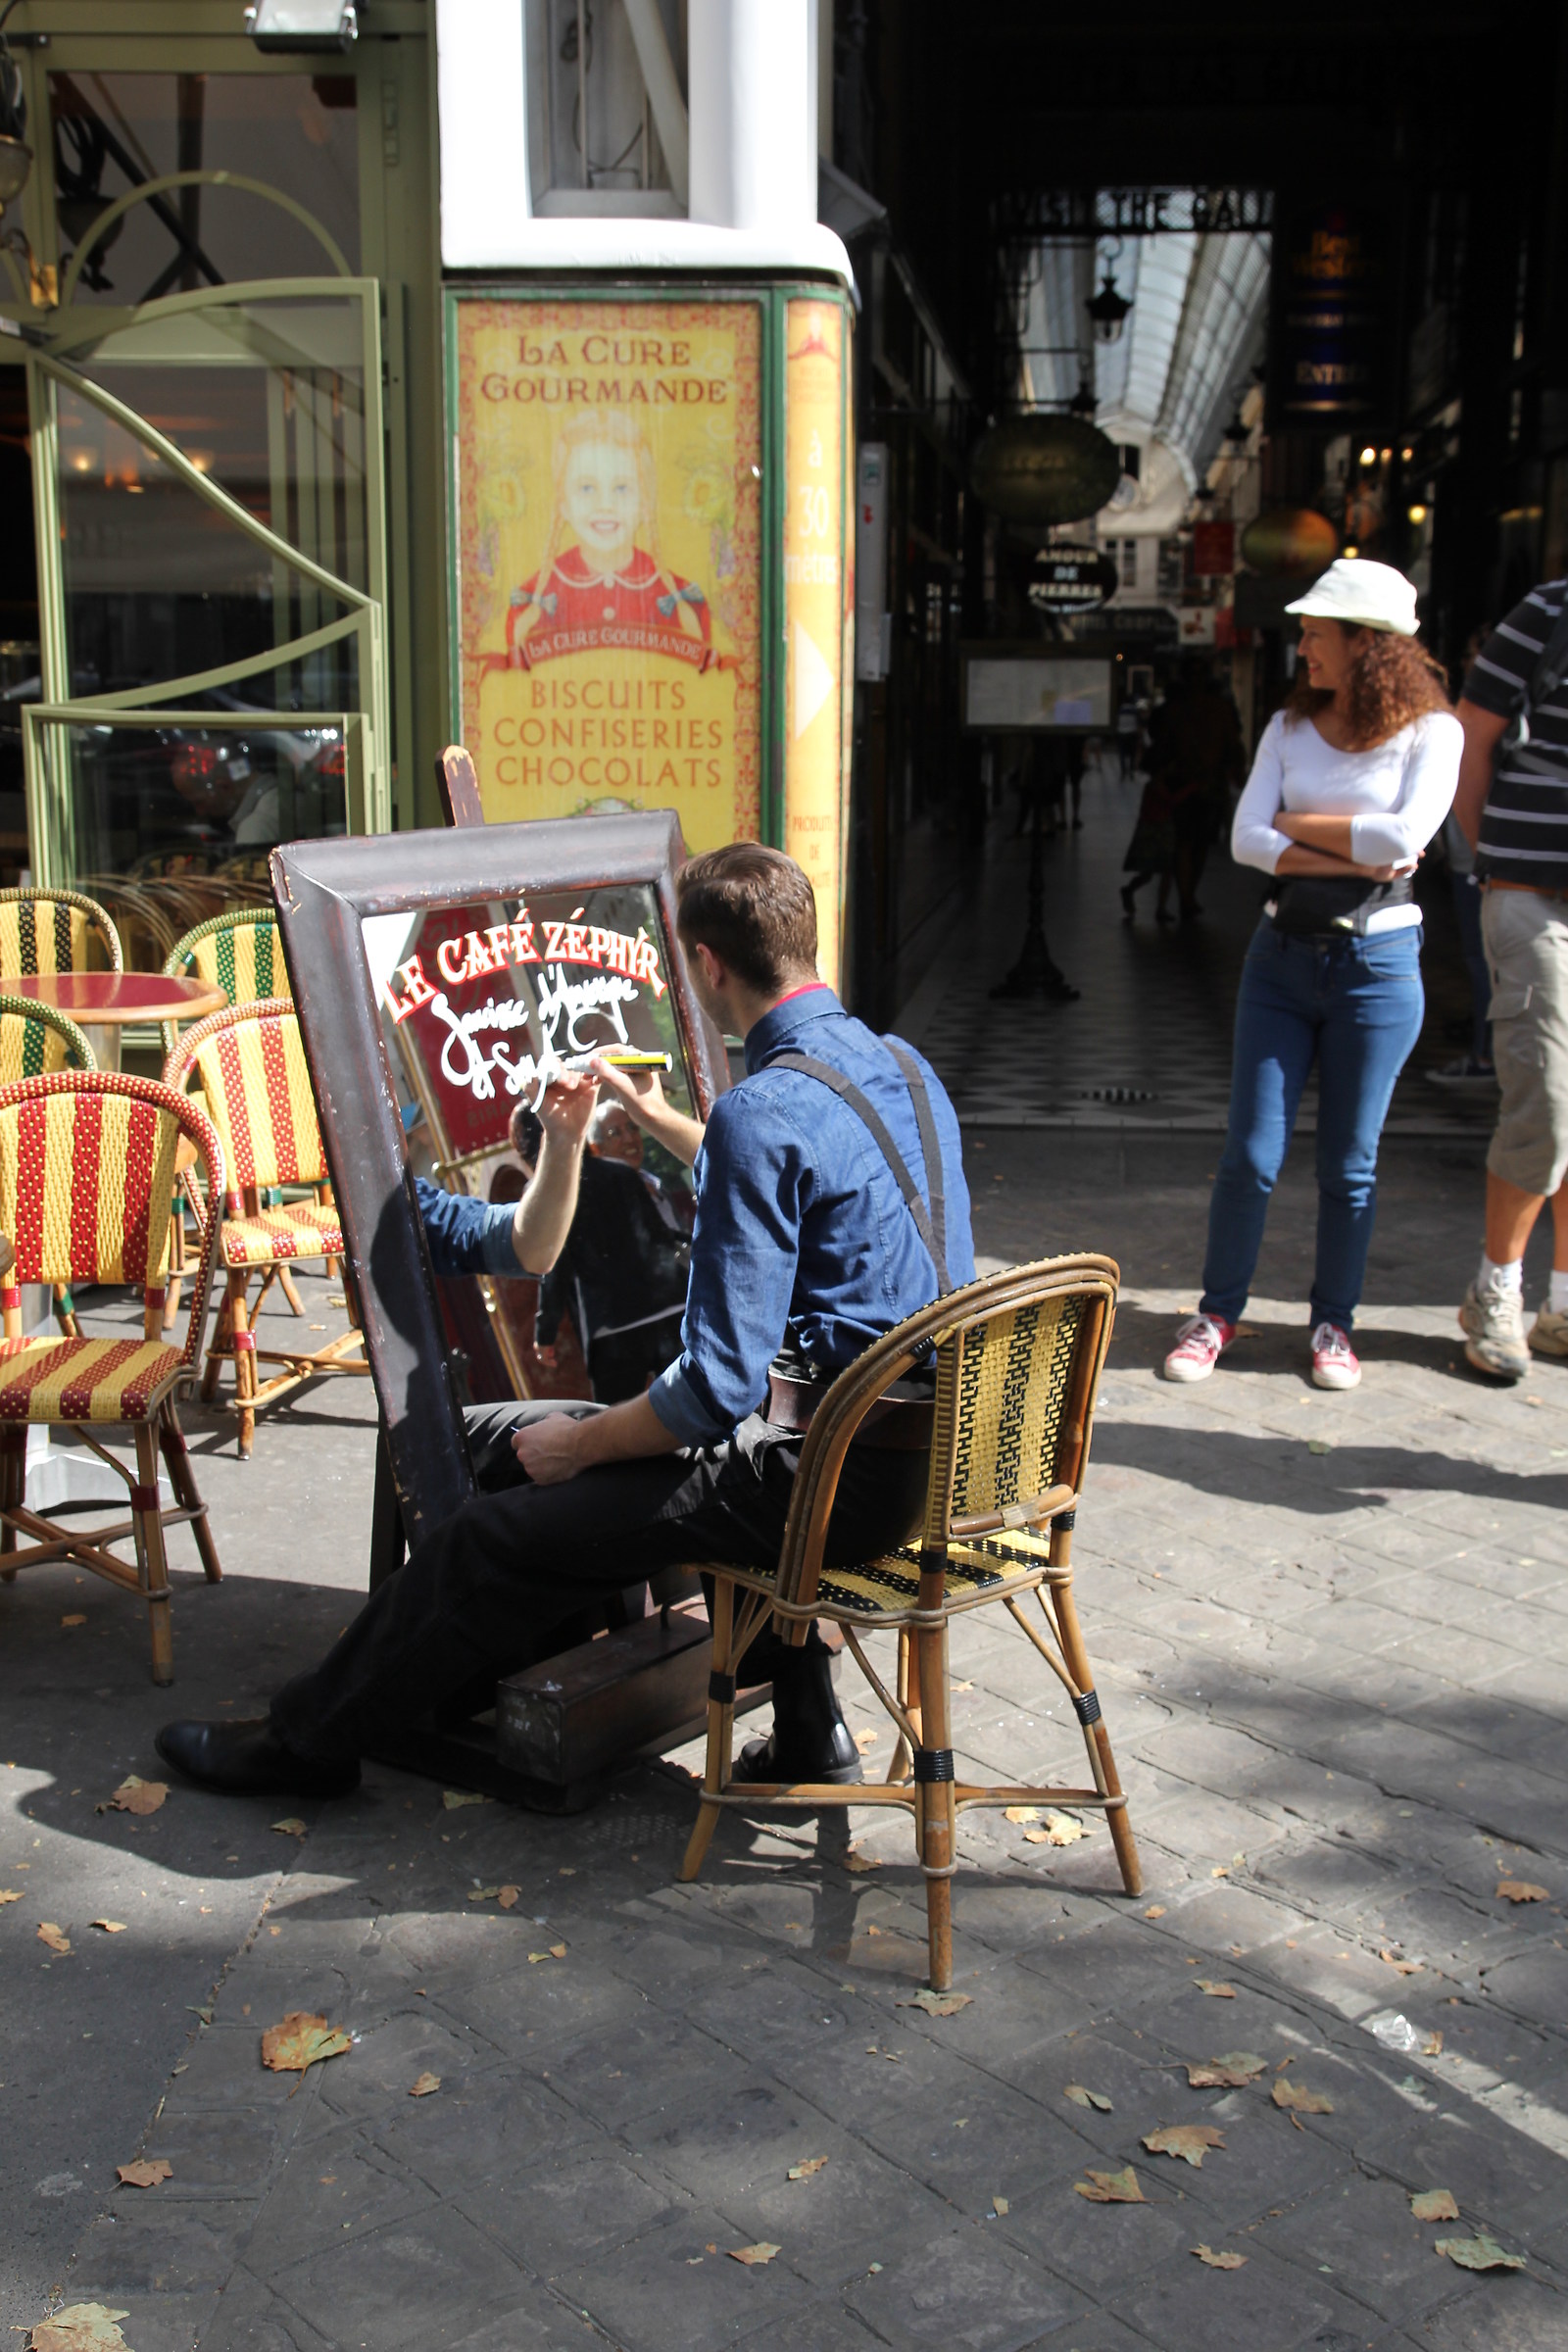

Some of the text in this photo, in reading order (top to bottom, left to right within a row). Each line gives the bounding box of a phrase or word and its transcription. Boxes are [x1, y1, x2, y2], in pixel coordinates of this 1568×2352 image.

[517, 334, 691, 367] LA CURE
[480, 371, 727, 404] GOURMANDE
[799, 485, 830, 538] 30
[1053, 564, 1080, 582] DE
[528, 625, 702, 660] LA CURE GOURMANDE
[530, 679, 686, 710] BISCUITS
[493, 716, 723, 750] CONFISERIES
[495, 756, 722, 788] CHOCOLATS
[808, 845, 820, 860] DE
[372, 906, 667, 1025] LE CAFÉ ZÉPHYR
